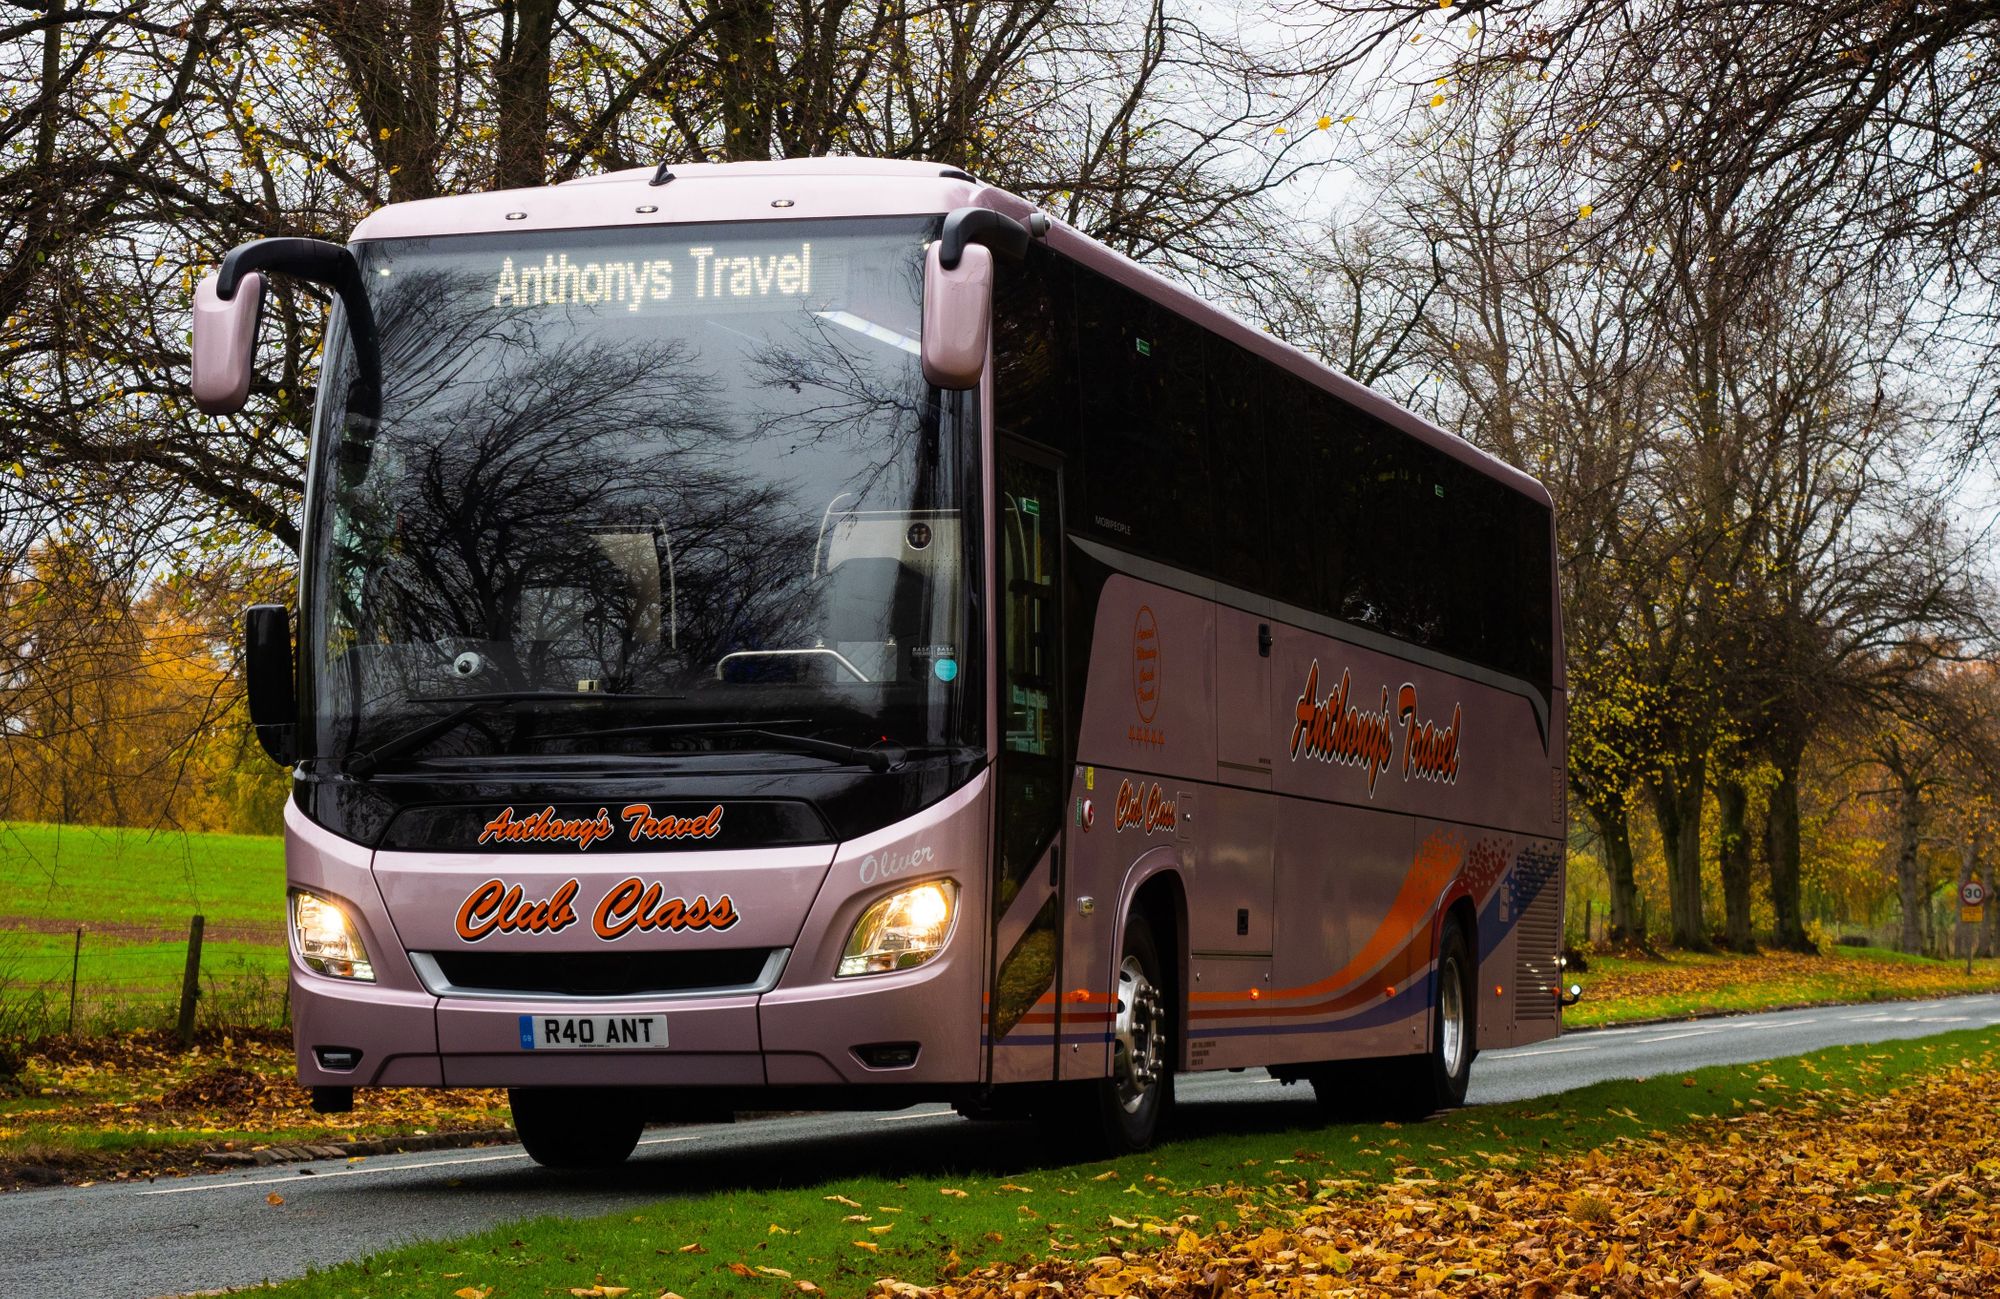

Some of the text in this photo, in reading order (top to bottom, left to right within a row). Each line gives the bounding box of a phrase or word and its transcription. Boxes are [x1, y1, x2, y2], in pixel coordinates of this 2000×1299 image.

[494, 243, 811, 311] Anthonys Travel
[1290, 658, 1461, 798] Anthony's Travel
[478, 804, 723, 850] Anthony's Travel
[1115, 778, 1146, 833] Club
[1145, 782, 1176, 836] Class
[859, 846, 935, 884] Oliver
[455, 877, 741, 943] Club Class
[1964, 888, 1982, 899] 30
[544, 1018, 653, 1044] R40 ANT
